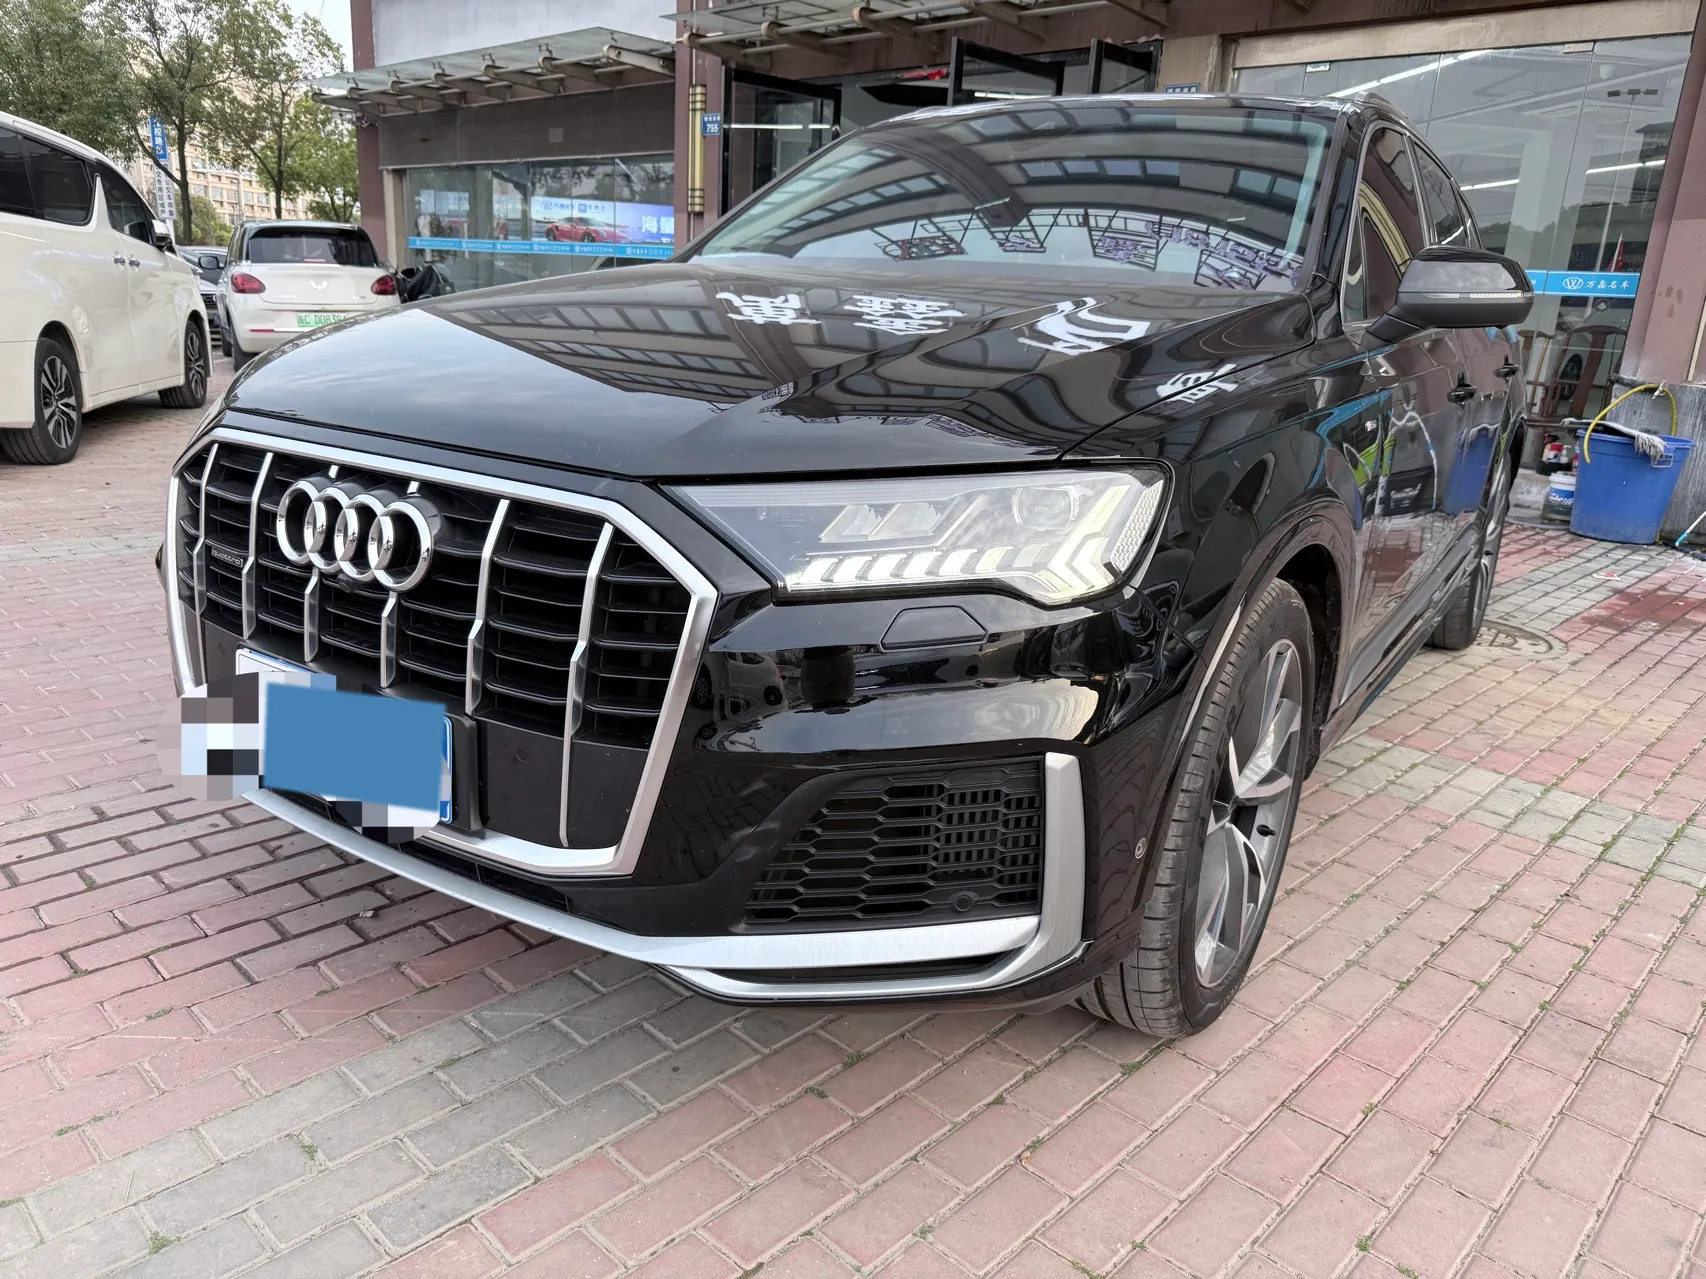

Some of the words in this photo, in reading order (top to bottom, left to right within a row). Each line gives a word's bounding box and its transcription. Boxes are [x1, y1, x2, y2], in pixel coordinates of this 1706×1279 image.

[706, 123, 719, 133] 755
[1585, 279, 1630, 290] 万鑫名车
[211, 549, 241, 565] quattro
